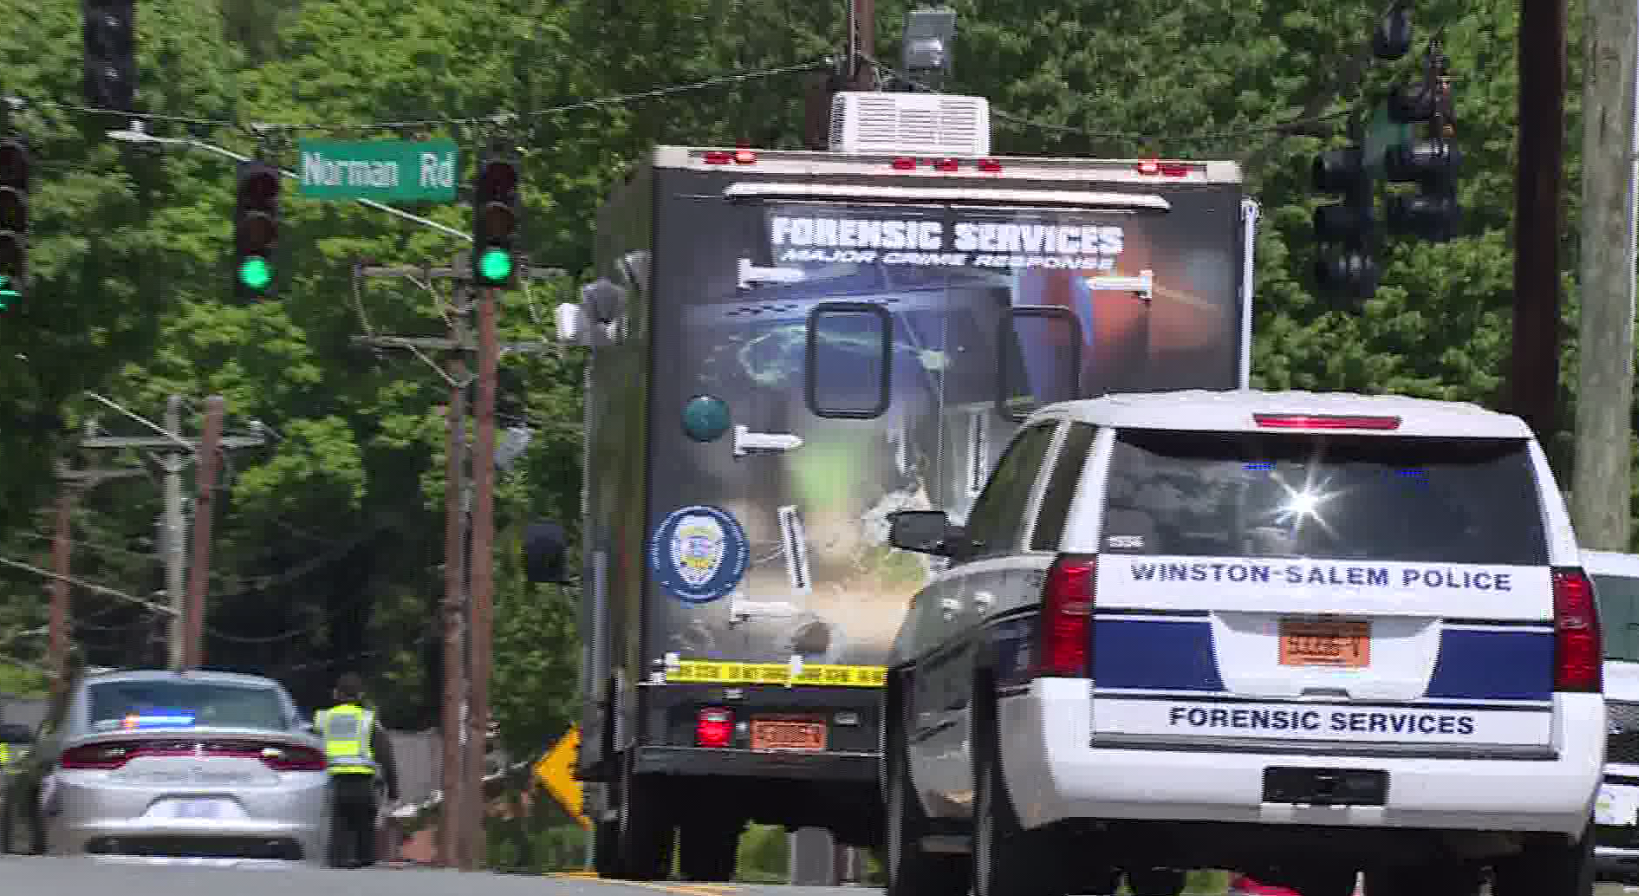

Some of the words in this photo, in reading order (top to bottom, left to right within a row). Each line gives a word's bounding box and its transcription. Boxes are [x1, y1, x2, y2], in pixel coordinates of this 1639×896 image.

[302, 152, 399, 186] Norman
[419, 152, 453, 187] Rd
[771, 217, 942, 249] FORENSIC
[954, 221, 1124, 253] SERVICES
[781, 249, 876, 264] MAJOR
[882, 252, 969, 268] CRIME
[973, 255, 1115, 270] RESPONSE
[1131, 562, 1389, 587] WINSTON-SALEM
[1403, 568, 1512, 592] POLICE
[1170, 706, 1319, 731] FORENSIC
[1330, 711, 1475, 735] SERVICES
